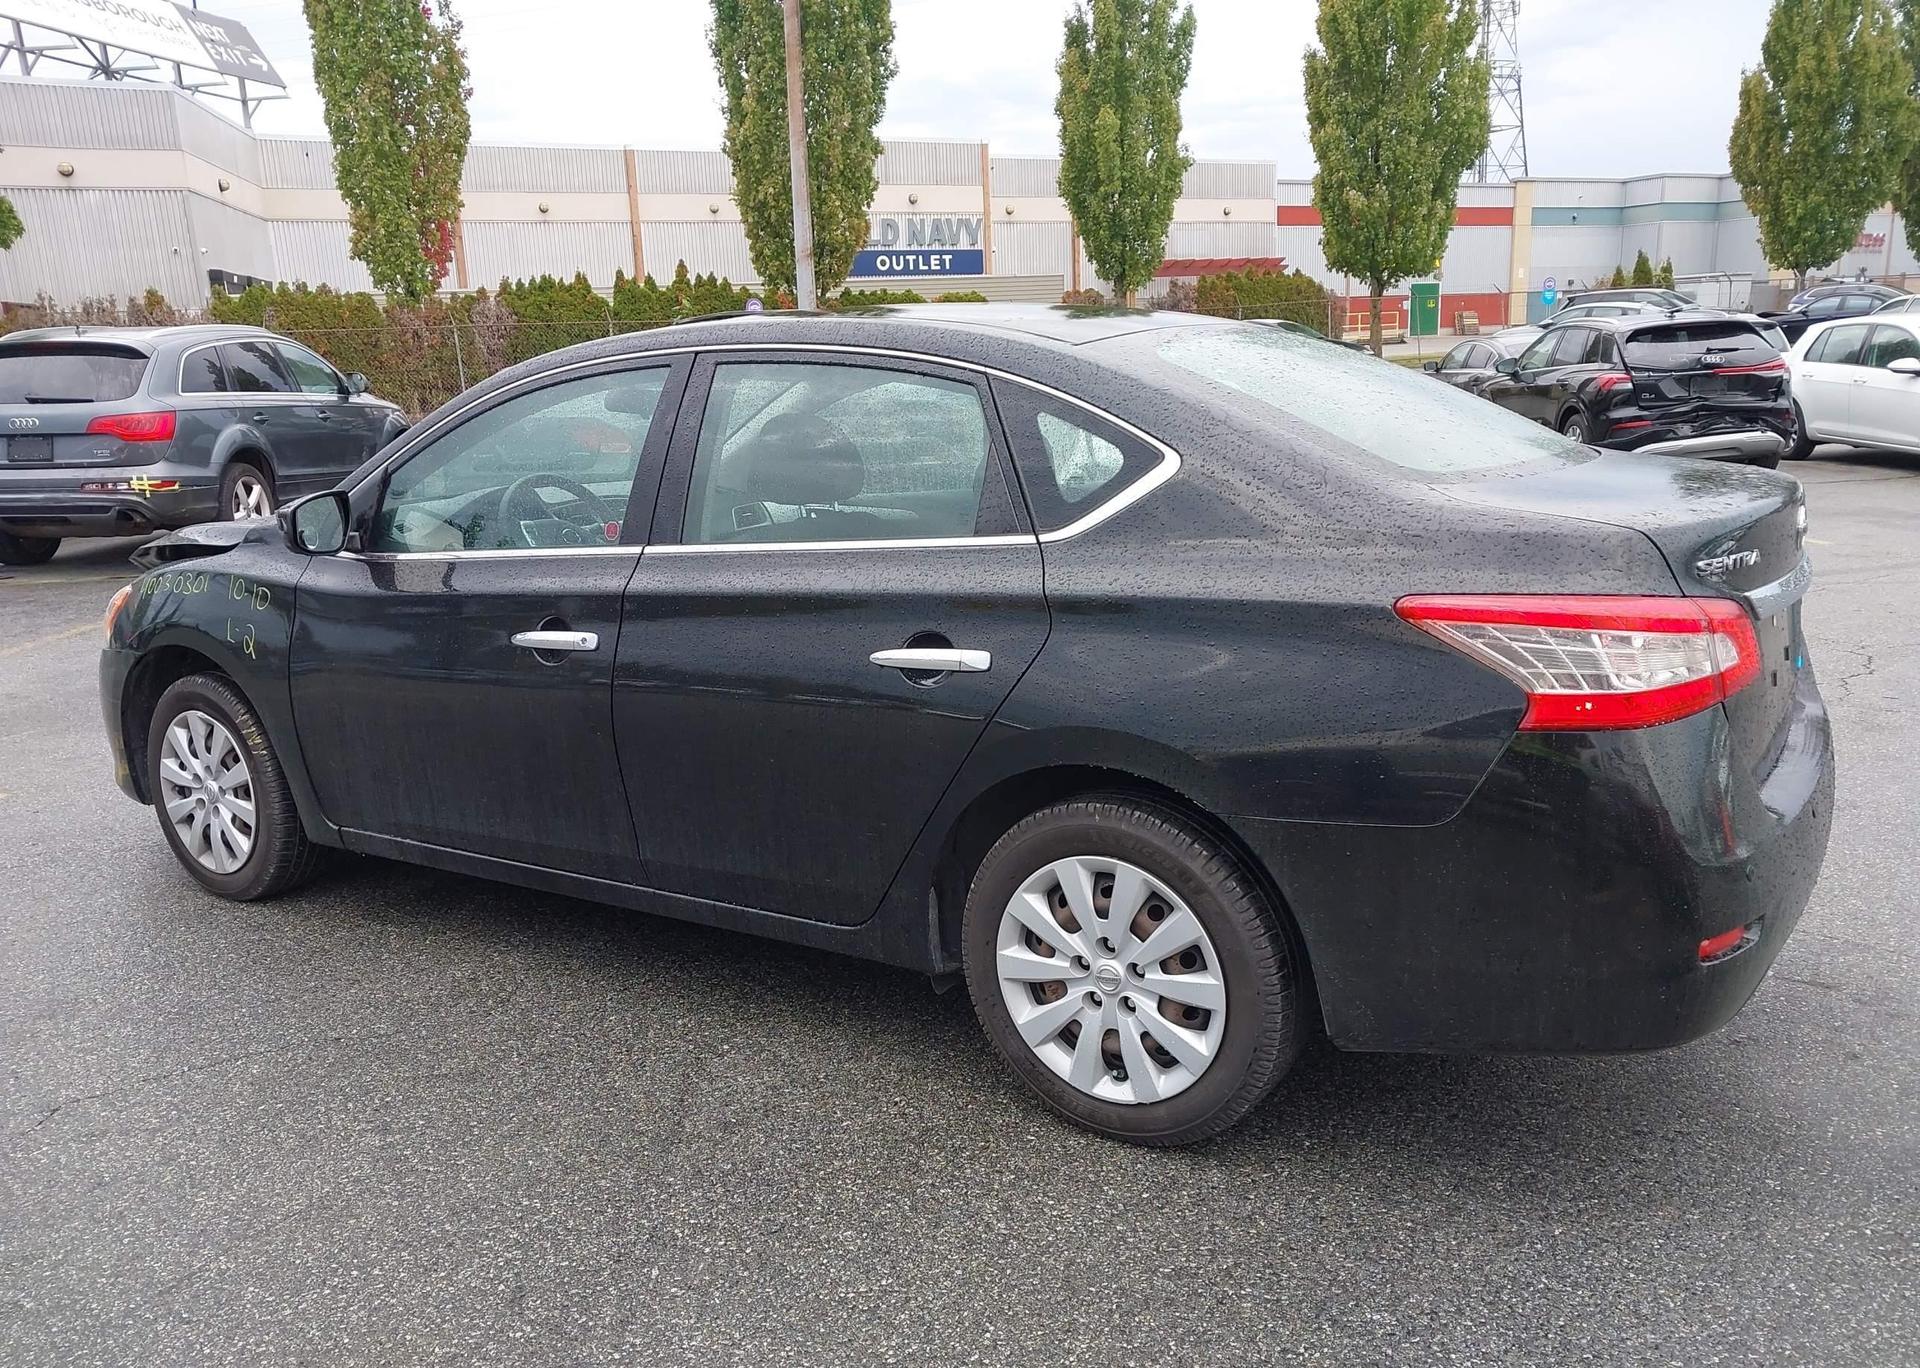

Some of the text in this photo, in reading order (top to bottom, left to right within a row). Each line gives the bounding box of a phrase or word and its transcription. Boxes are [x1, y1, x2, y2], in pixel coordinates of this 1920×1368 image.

[188, 18, 230, 43] NEXT
[204, 42, 248, 66] EXIT
[907, 217, 983, 246] NAVY
[876, 254, 952, 271] OUTLET
[1696, 548, 1760, 575] SENTRA
